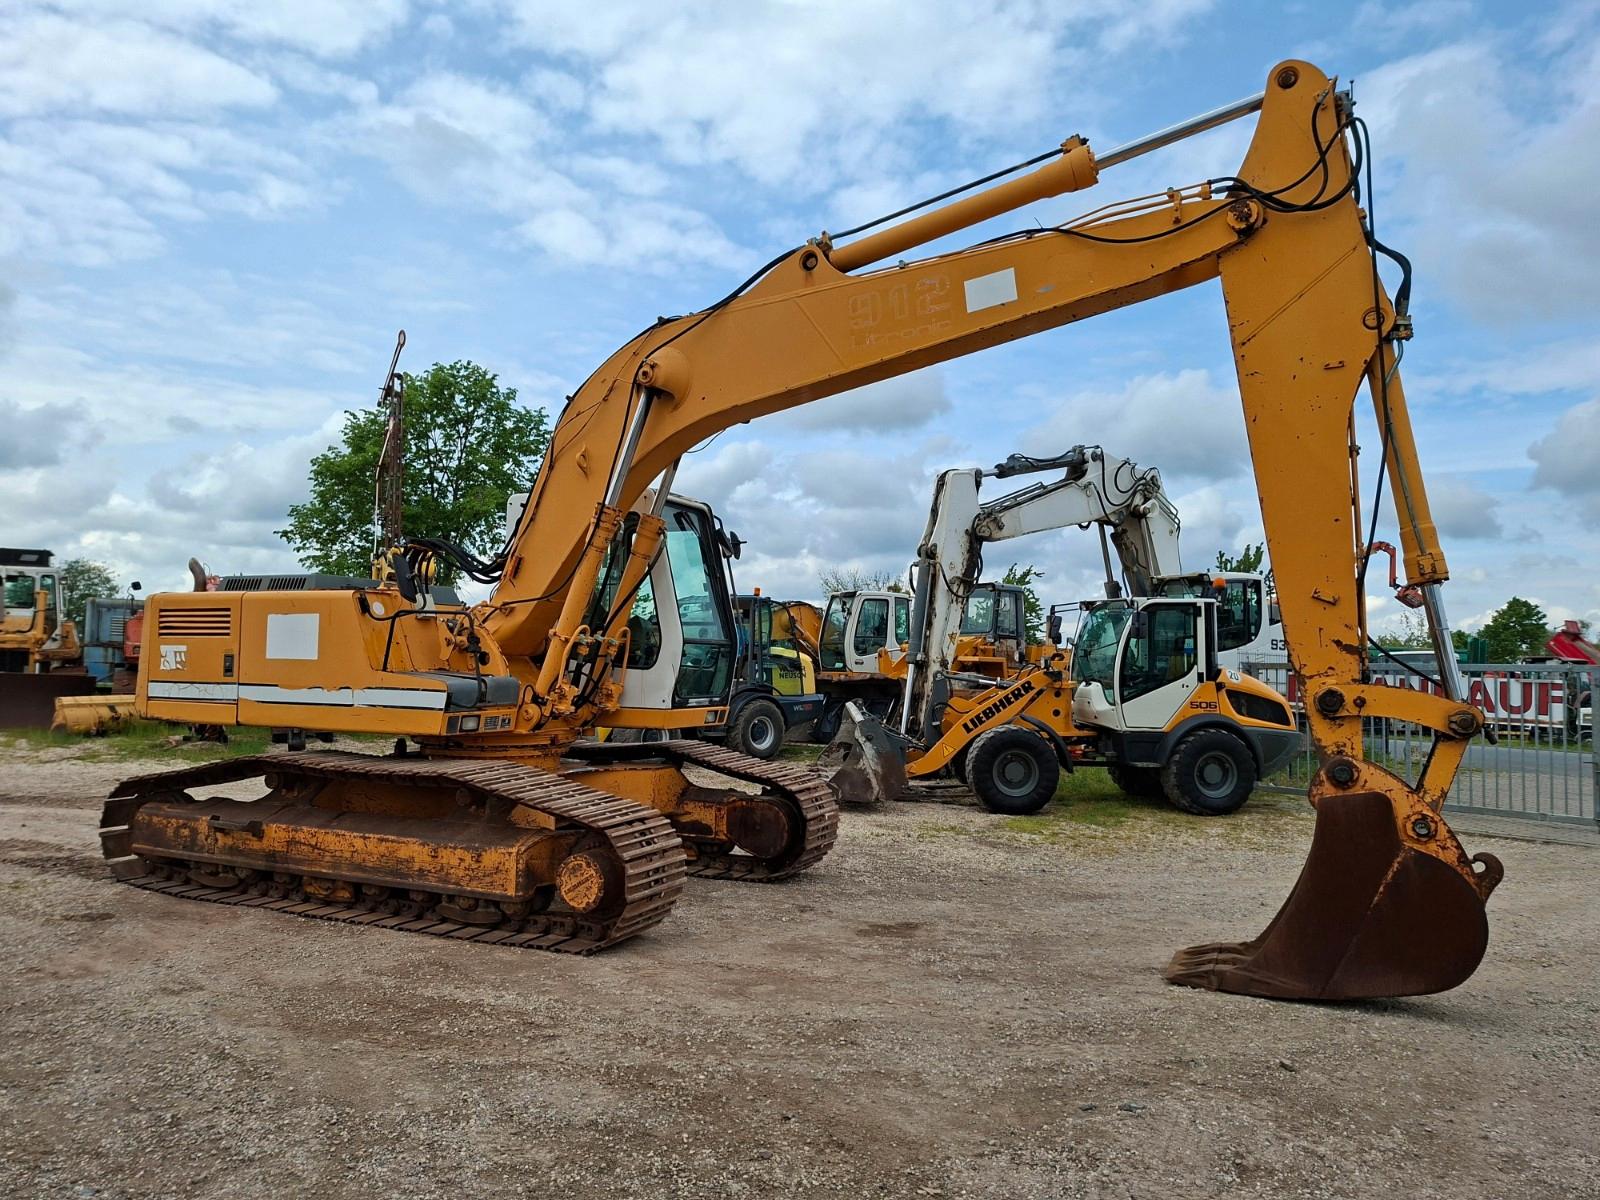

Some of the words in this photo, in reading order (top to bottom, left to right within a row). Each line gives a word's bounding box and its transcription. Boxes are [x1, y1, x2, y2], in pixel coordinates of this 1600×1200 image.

[849, 275, 952, 329] 912
[1271, 639, 1286, 650] 93
[1228, 670, 1239, 680] 20
[962, 680, 1036, 734] LIEBHERR
[1190, 701, 1217, 709] 506
